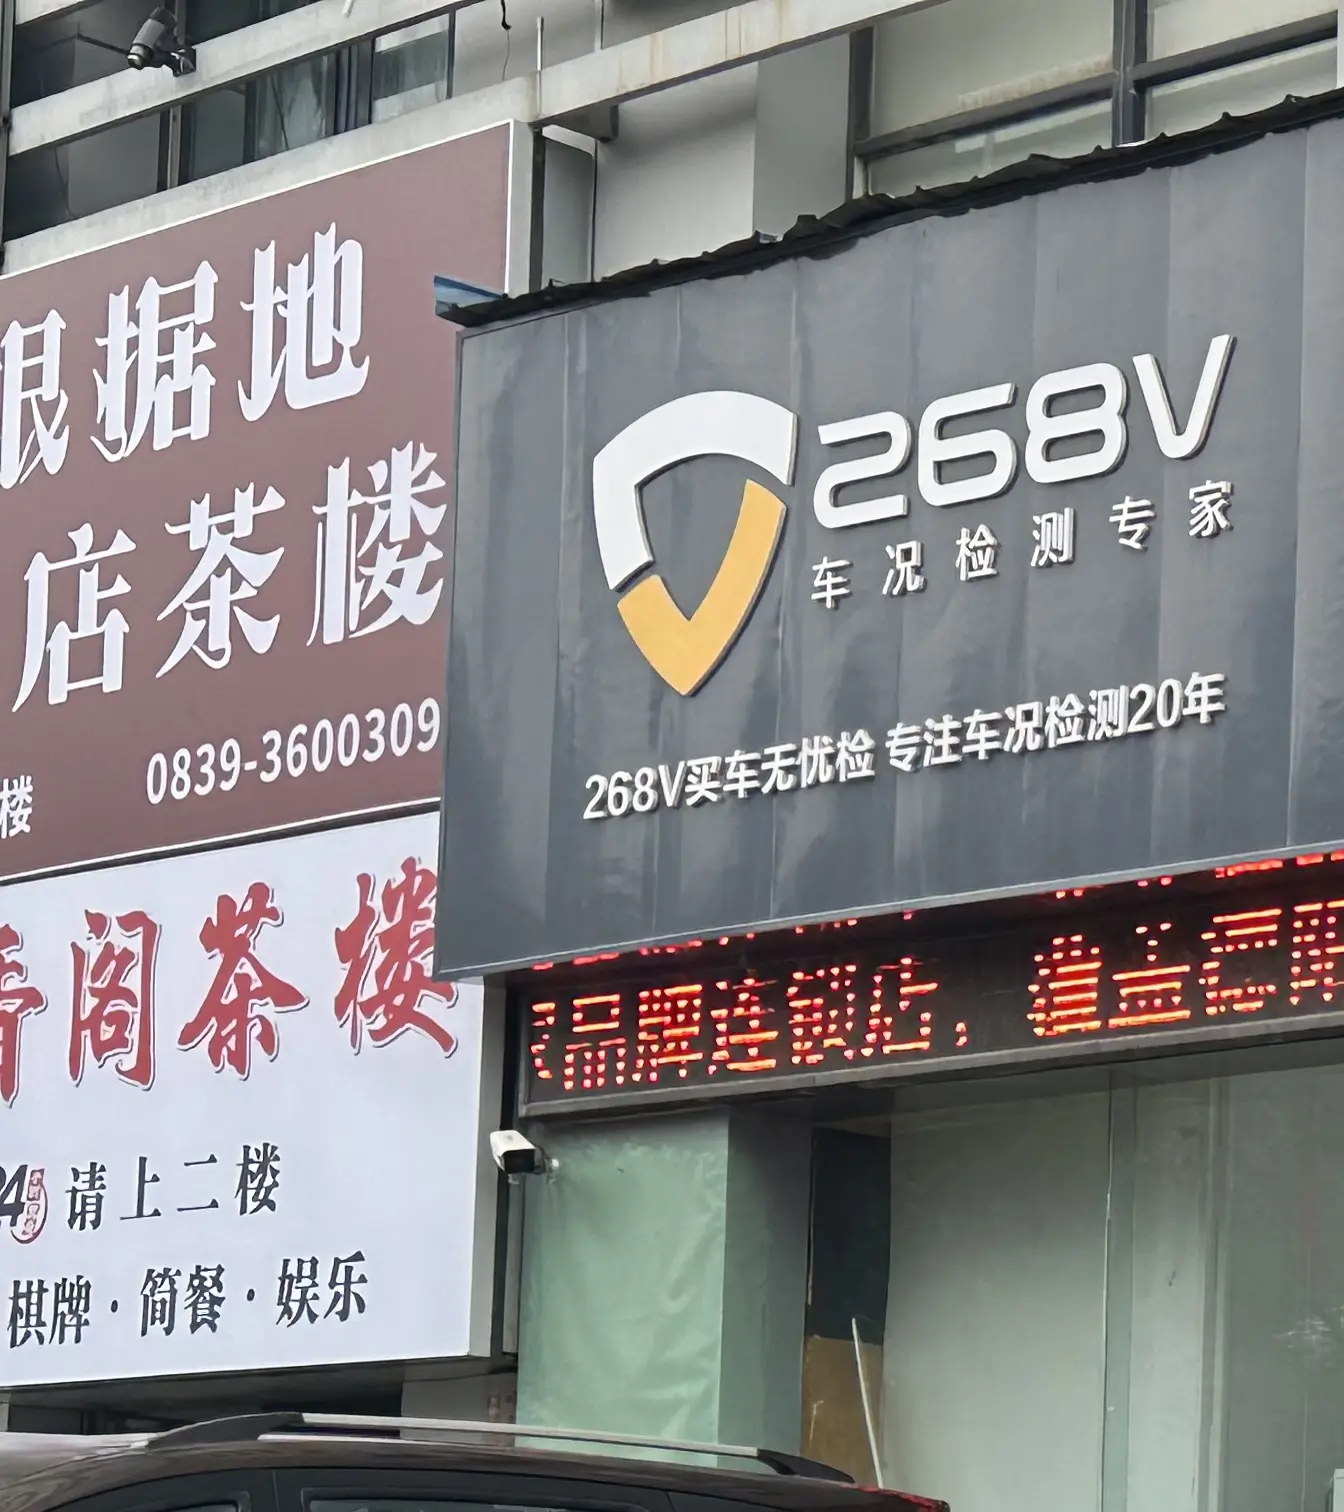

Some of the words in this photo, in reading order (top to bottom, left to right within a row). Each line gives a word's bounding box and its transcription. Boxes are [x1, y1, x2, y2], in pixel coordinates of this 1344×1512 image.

[812, 333, 1236, 529] 268V
[811, 479, 1234, 609] 车况检测专家
[146, 697, 441, 805] 0839-3600309
[582, 728, 876, 820] 268V买车无忧检
[885, 671, 1228, 773] 专注车况检测20年
[65, 1142, 281, 1231] 请上二楼
